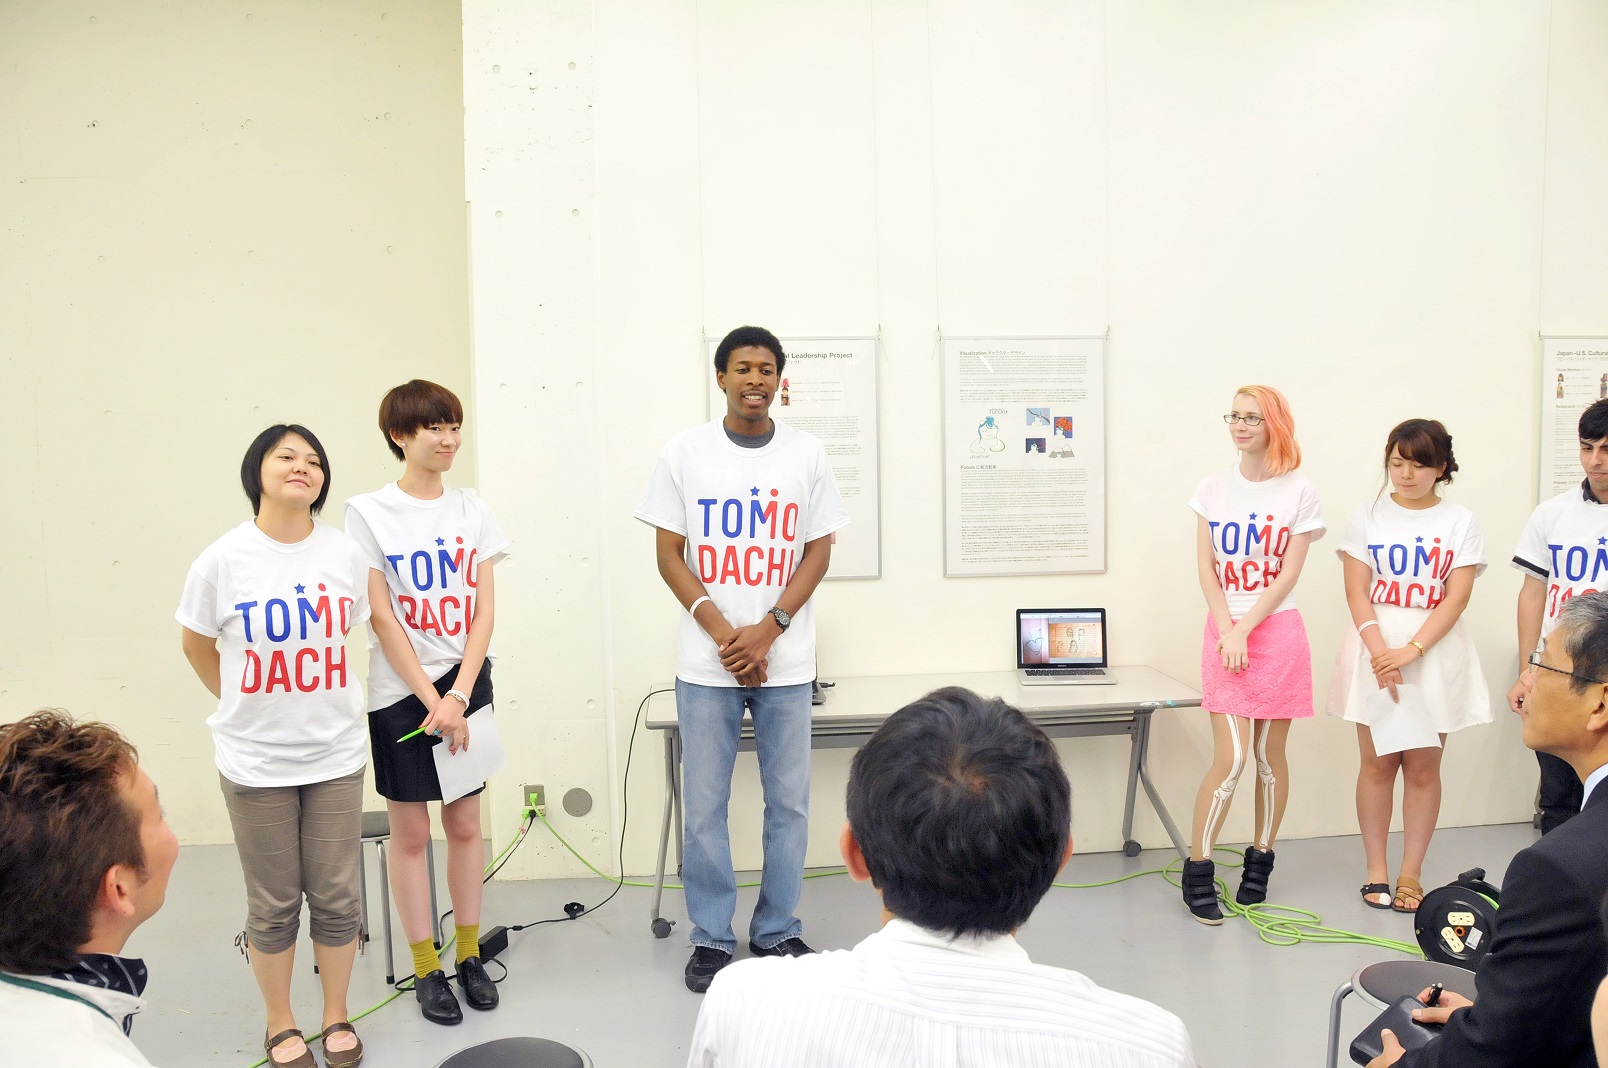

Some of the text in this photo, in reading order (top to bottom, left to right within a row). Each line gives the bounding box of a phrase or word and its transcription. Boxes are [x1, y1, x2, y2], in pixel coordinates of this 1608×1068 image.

[829, 351, 853, 359] Project
[698, 486, 799, 542] TOMO
[1209, 512, 1291, 557] TOMO
[386, 536, 478, 591] TOMO
[1367, 536, 1455, 580] TOMO
[234, 583, 354, 643] TOMO
